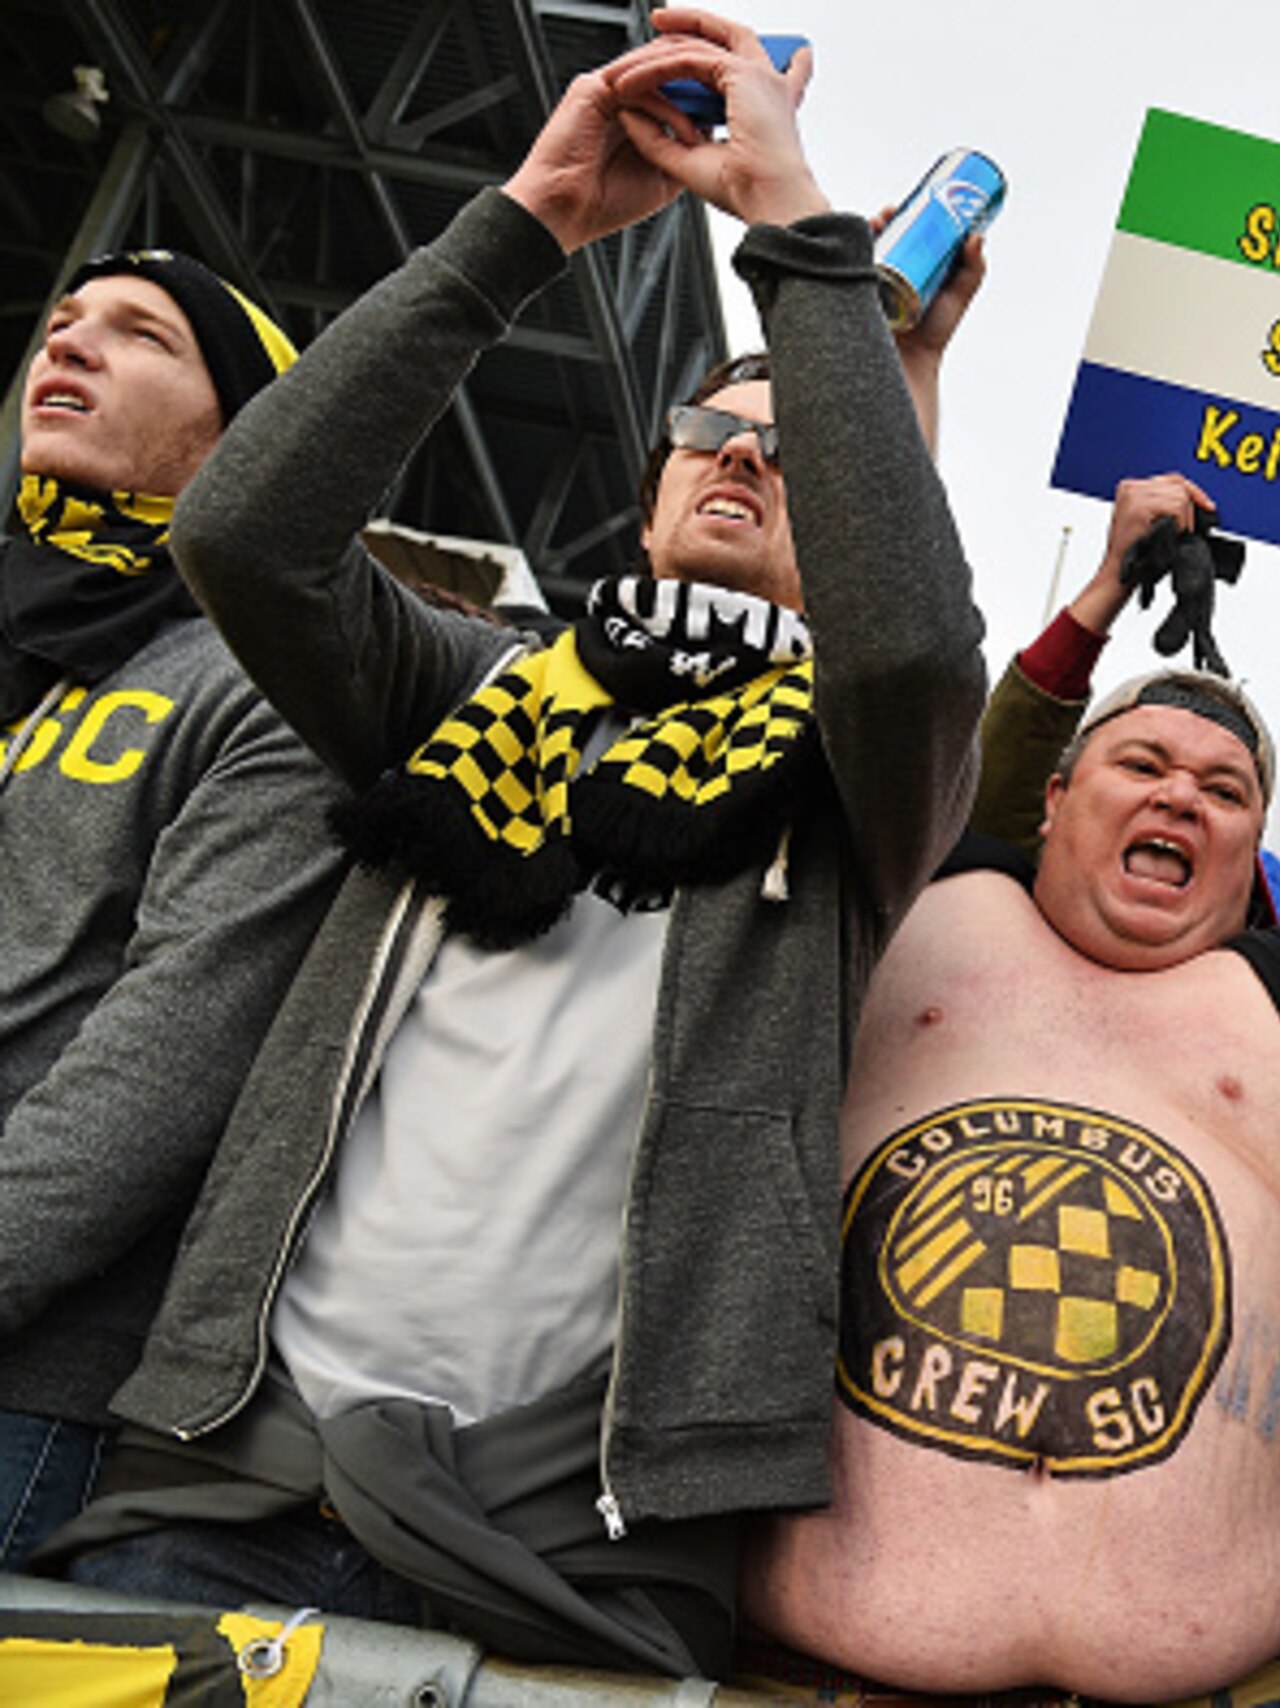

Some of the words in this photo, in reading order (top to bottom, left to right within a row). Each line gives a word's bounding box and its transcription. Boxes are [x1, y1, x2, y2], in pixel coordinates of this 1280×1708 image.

[885, 1111, 1183, 1204] COLUMBUS
[870, 1336, 1051, 1438] CREW
[1085, 1377, 1165, 1450] SC
